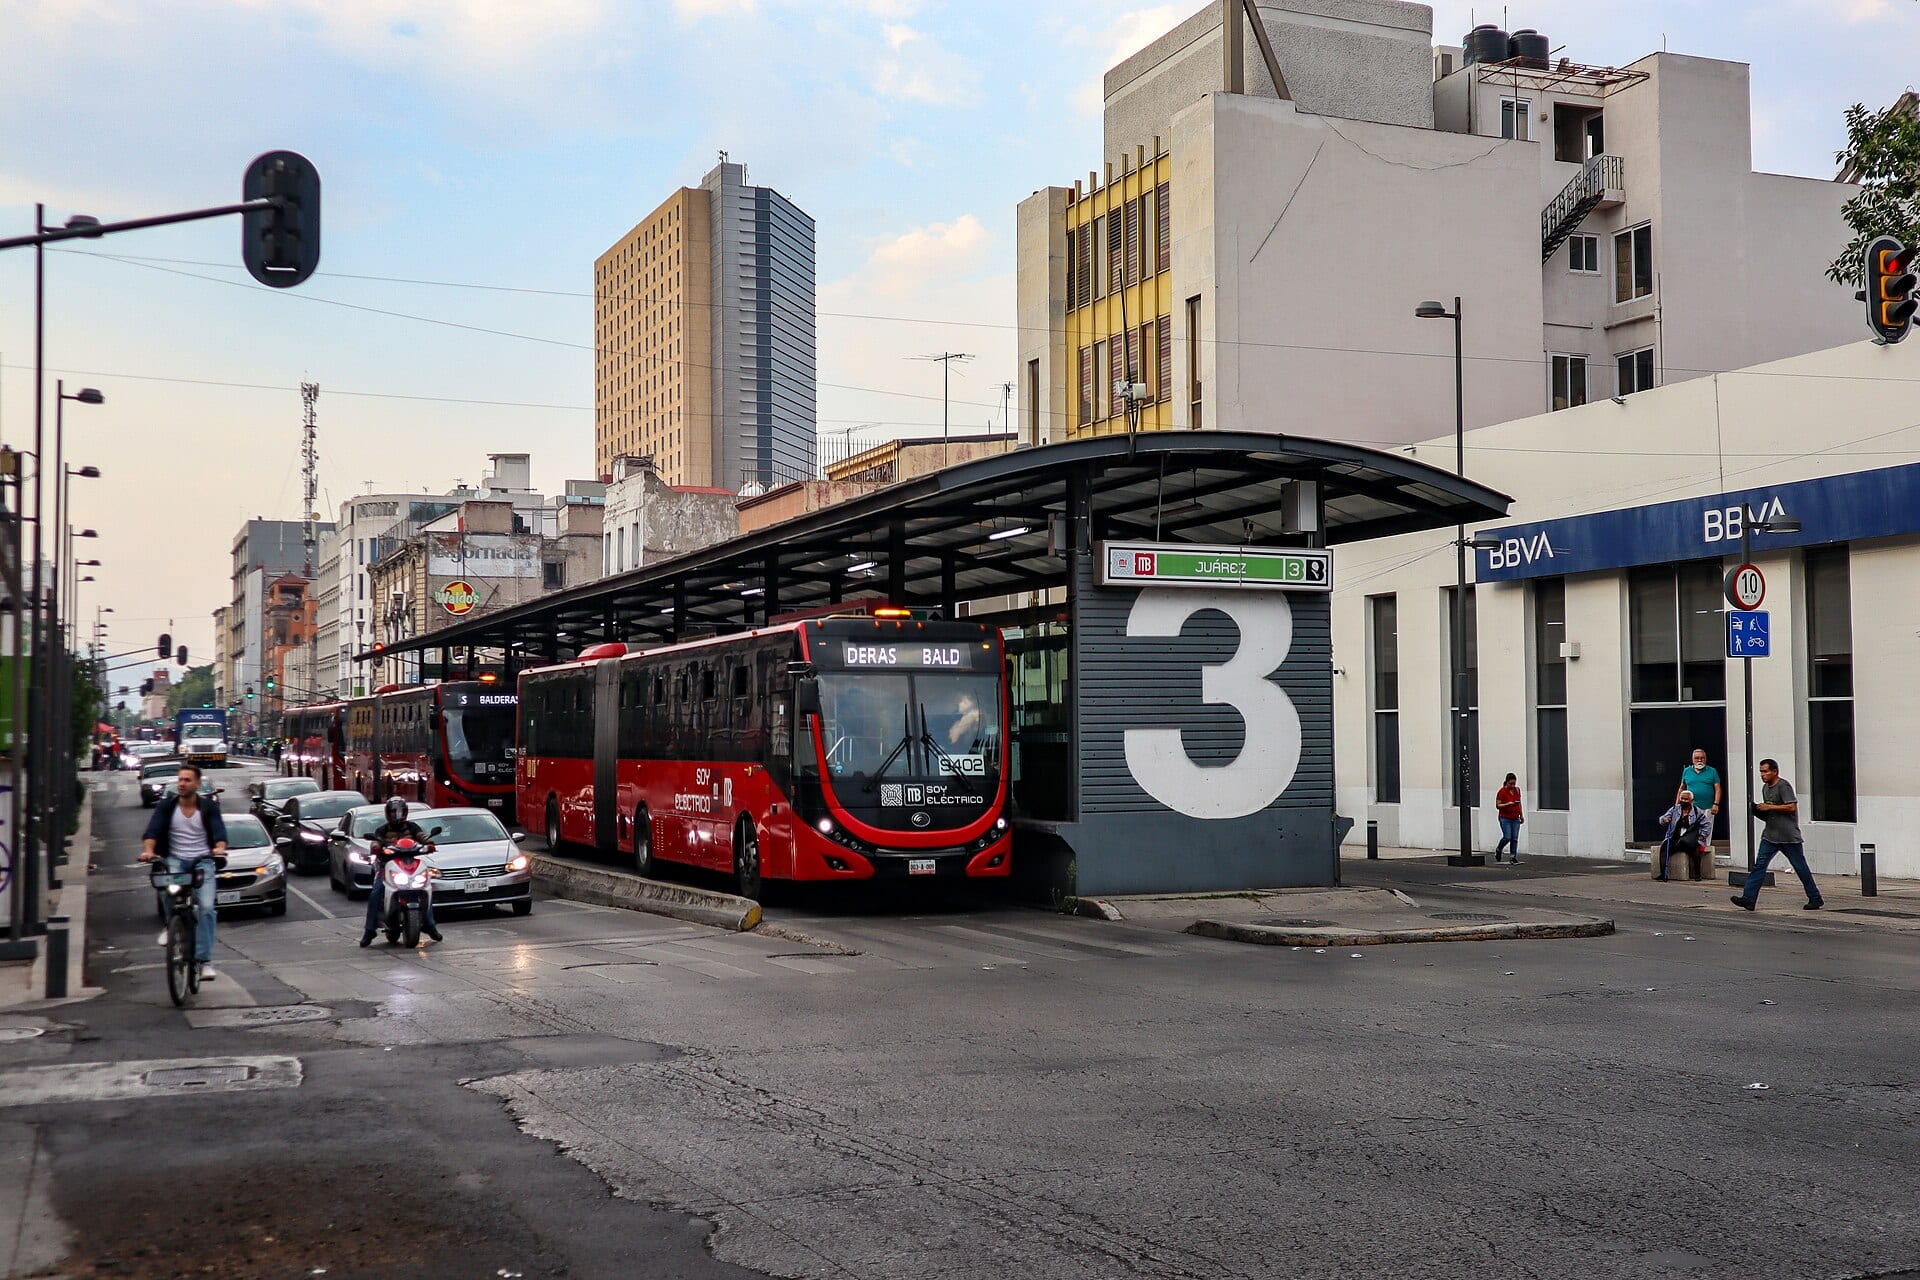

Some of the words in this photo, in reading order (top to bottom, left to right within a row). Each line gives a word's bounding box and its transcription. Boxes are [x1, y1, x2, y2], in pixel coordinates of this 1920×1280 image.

[1704, 496, 1786, 543] BBVA
[1489, 531, 1554, 570] BBVA
[1195, 559, 1247, 574] JUÁREZ
[1289, 562, 1300, 577] 3
[1742, 573, 1757, 594] 10
[434, 591, 480, 604] Waldo's
[847, 647, 897, 664] DERAS
[922, 648, 960, 665] BALD
[1124, 588, 1301, 819] 3
[696, 768, 711, 786] SOY
[926, 785, 948, 794] SOY
